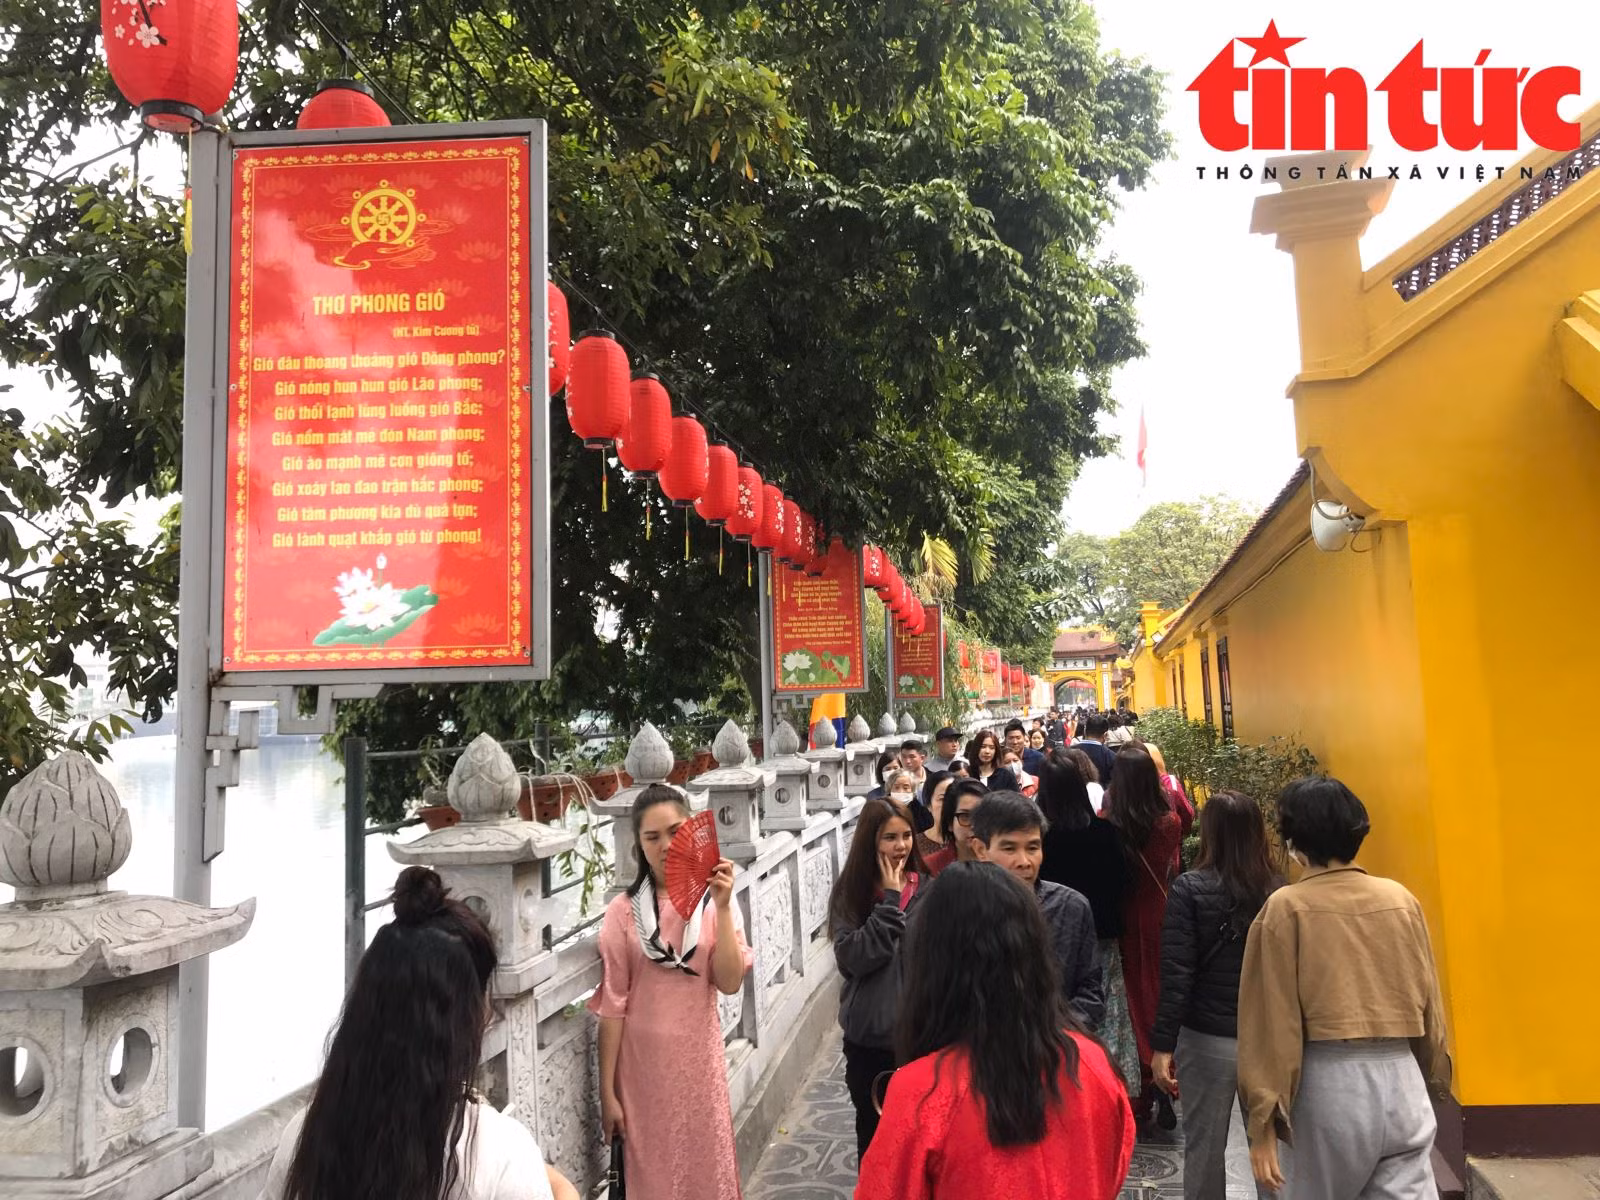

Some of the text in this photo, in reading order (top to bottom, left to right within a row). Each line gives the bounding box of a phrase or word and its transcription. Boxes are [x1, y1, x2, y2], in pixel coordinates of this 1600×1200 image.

[312, 288, 445, 315] THƠ PHONG GIÓ
[412, 326, 432, 336] Kim
[253, 356, 274, 371] Gió
[304, 355, 347, 370] thoang
[398, 351, 418, 368] gió
[422, 350, 454, 366] Đông
[458, 349, 505, 366] phong?
[275, 381, 296, 396] Gió
[299, 380, 330, 395] nóng
[334, 379, 357, 393] hun
[361, 378, 384, 393] hun
[388, 377, 408, 393] gió
[438, 376, 483, 391] phong;
[274, 406, 295, 421] Gió
[327, 404, 354, 421] lạnh
[430, 401, 450, 417] gió
[453, 399, 483, 416] Bắc;
[272, 431, 292, 446] Gió
[407, 427, 436, 441] Nam
[441, 426, 485, 442] phong;
[282, 456, 303, 471] Gió
[326, 454, 361, 472] mạnh
[272, 481, 293, 496] Gió
[330, 480, 351, 494] lao
[439, 477, 484, 493] phong;
[277, 507, 298, 522] Gió
[381, 504, 401, 519] kia
[272, 533, 293, 548] Gió
[328, 531, 357, 548] quạt
[396, 529, 416, 546] gió
[437, 527, 481, 545] phong!
